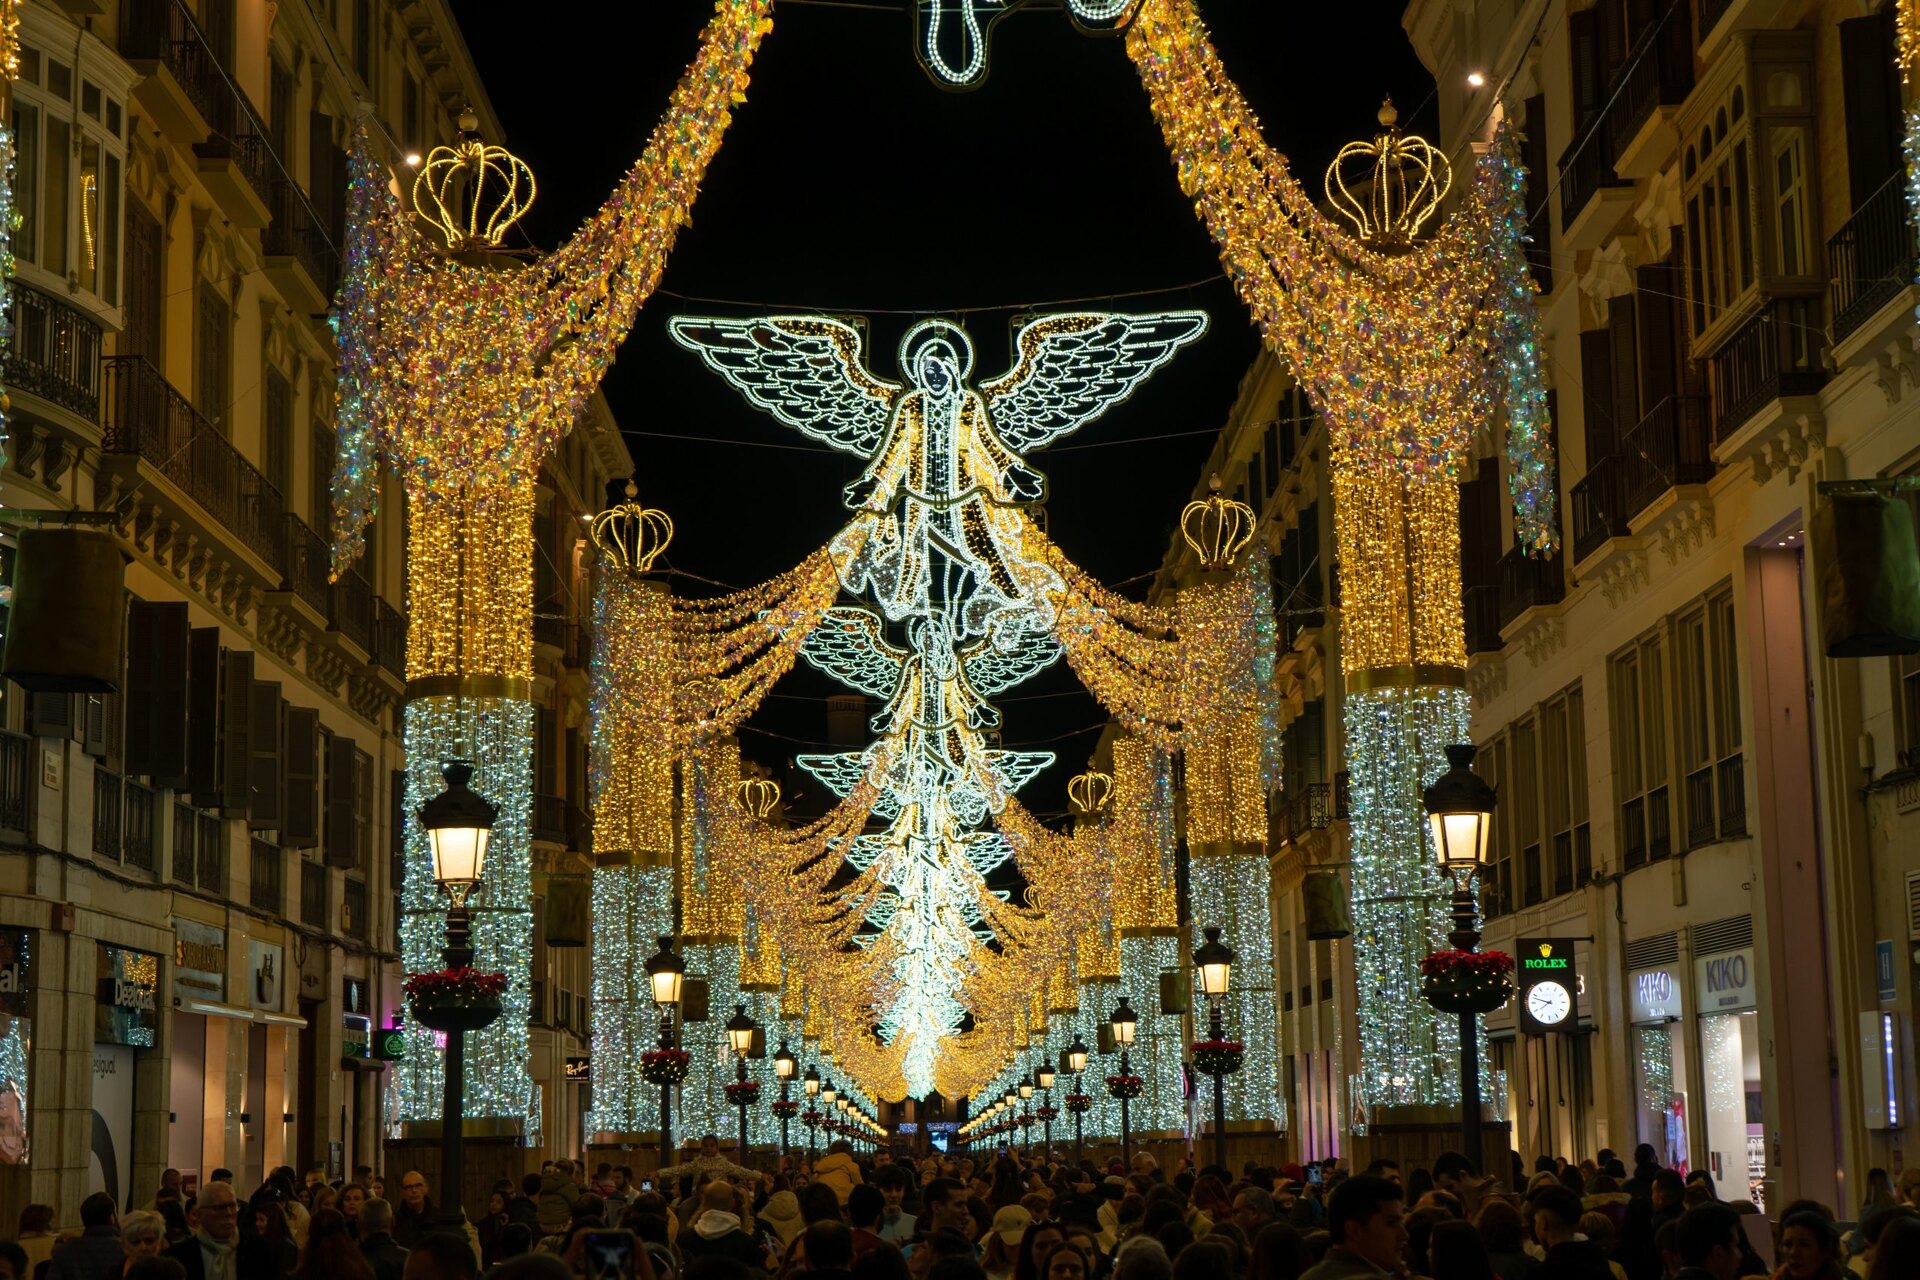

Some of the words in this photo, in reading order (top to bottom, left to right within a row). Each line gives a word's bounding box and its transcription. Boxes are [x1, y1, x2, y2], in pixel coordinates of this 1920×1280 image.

[1525, 958, 1568, 969] ROLEX
[1706, 954, 1748, 993] KIKO
[1638, 969, 1672, 1004] KIKO
